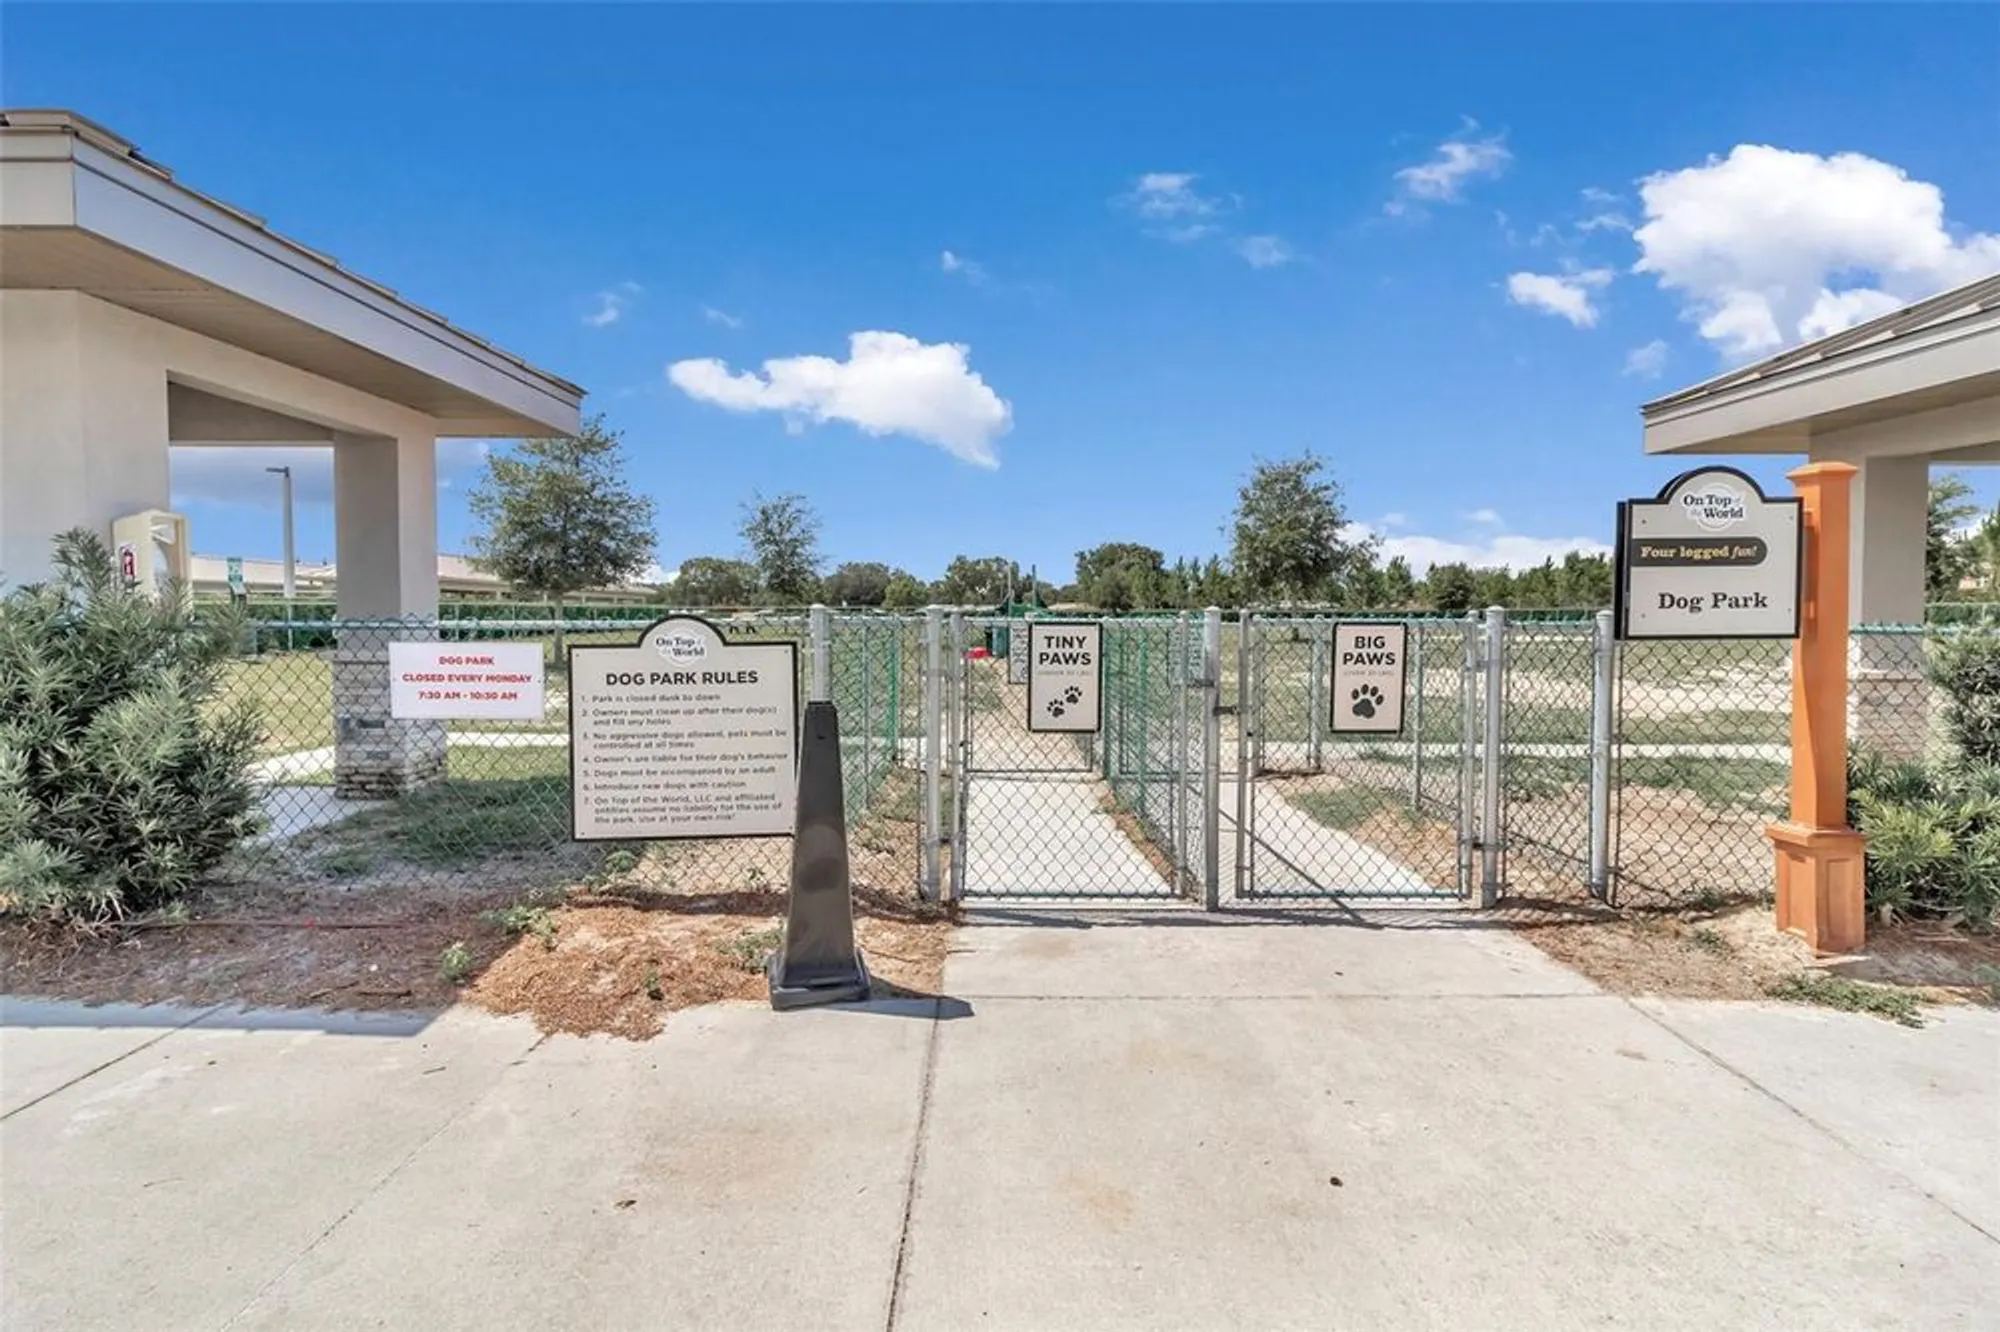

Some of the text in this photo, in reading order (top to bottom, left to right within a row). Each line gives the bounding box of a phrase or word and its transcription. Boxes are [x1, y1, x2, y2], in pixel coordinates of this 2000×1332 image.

[1683, 494, 1704, 506] On
[1706, 494, 1731, 508] Top
[1704, 507, 1744, 518] World
[1640, 546, 1677, 558] Four
[1657, 592, 1768, 613] Dog Park
[656, 638, 673, 646] On
[675, 638, 695, 648] Top
[1044, 636, 1087, 649] TINY
[1354, 636, 1386, 649] BIG
[672, 648, 705, 657] World
[438, 656, 495, 666] DOG PARK
[1039, 652, 1092, 666] PAWS
[1343, 652, 1396, 666] PAWS
[402, 673, 533, 683] CLOSED EVERY MONDAY
[606, 670, 759, 686] DOG PARK RULES
[418, 691, 441, 700] 7:30
[443, 691, 461, 700] AM
[470, 691, 498, 700] 10:30
[500, 691, 518, 700] AM
[592, 695, 613, 703] Park
[625, 694, 657, 702] closed
[592, 708, 628, 717] Owners
[630, 708, 654, 717] must
[697, 706, 720, 716] after
[721, 706, 744, 715] their
[593, 718, 611, 726] and
[627, 718, 645, 728] any
[646, 717, 672, 726] holes
[593, 732, 607, 740] No
[727, 729, 748, 740] pets
[750, 729, 773, 738] must
[775, 728, 787, 737] be
[593, 741, 641, 750] controlled
[643, 741, 653, 750] at
[668, 740, 695, 749] times
[651, 754, 677, 762] liable
[679, 753, 694, 762] for
[695, 753, 718, 761] their
[747, 752, 788, 761] behavior
[593, 769, 619, 779] Dogs
[620, 768, 643, 777] must
[645, 768, 658, 776] be
[724, 766, 736, 776] by
[752, 765, 776, 774] adult
[593, 782, 640, 790] Introduce
[689, 781, 709, 789] with
[711, 780, 747, 789] caution
[593, 796, 609, 805] On
[611, 796, 629, 806] Top
[630, 795, 641, 804] of
[642, 795, 657, 804] the
[714, 793, 732, 802] and
[631, 806, 667, 814] assume
[683, 804, 717, 815] liability
[719, 803, 734, 812] for
[735, 803, 752, 811] the
[771, 801, 782, 811] of
[593, 815, 611, 824] the
[658, 815, 668, 823] at
[670, 815, 692, 825] your
